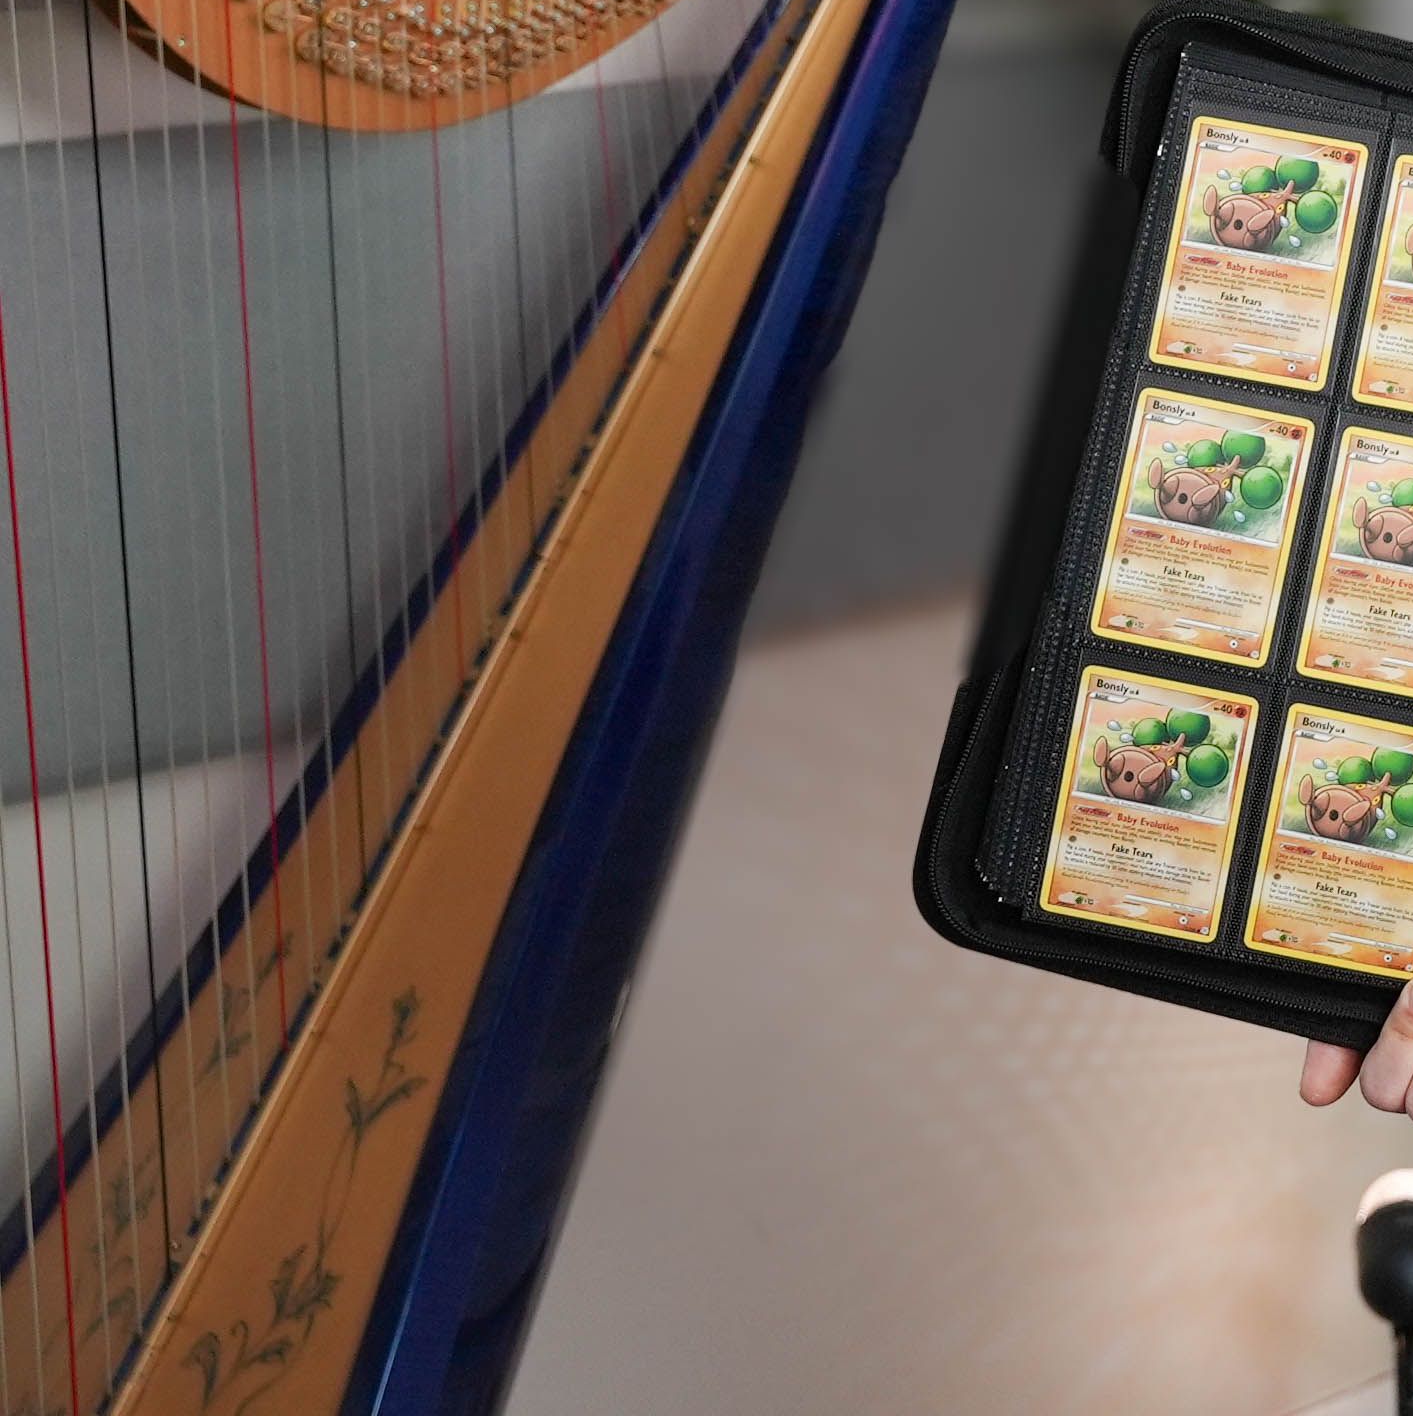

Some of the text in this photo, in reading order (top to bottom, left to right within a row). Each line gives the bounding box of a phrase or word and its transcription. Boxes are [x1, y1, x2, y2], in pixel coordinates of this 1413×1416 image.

[1206, 128, 1342, 161] Bonsly 40
[1225, 261, 1289, 280] Baby Evolution
[1219, 292, 1262, 308] Fake Tears
[1152, 400, 1289, 436] Bonsly 40
[1356, 439, 1390, 456] Bonsly
[1169, 535, 1233, 555] Baby Evolution
[1162, 566, 1206, 583] Fake Tears
[1375, 574, 1396, 587] Baby
[1368, 606, 1412, 622] Fake Tears
[1096, 679, 1233, 714] Bonsly 40
[1302, 717, 1335, 734] Bonsly
[1116, 813, 1180, 833] Baby Evolution
[1110, 844, 1154, 860] Fake Tears
[1321, 851, 1385, 872] Baby Evolution
[1315, 882, 1358, 899] Fake Tears
